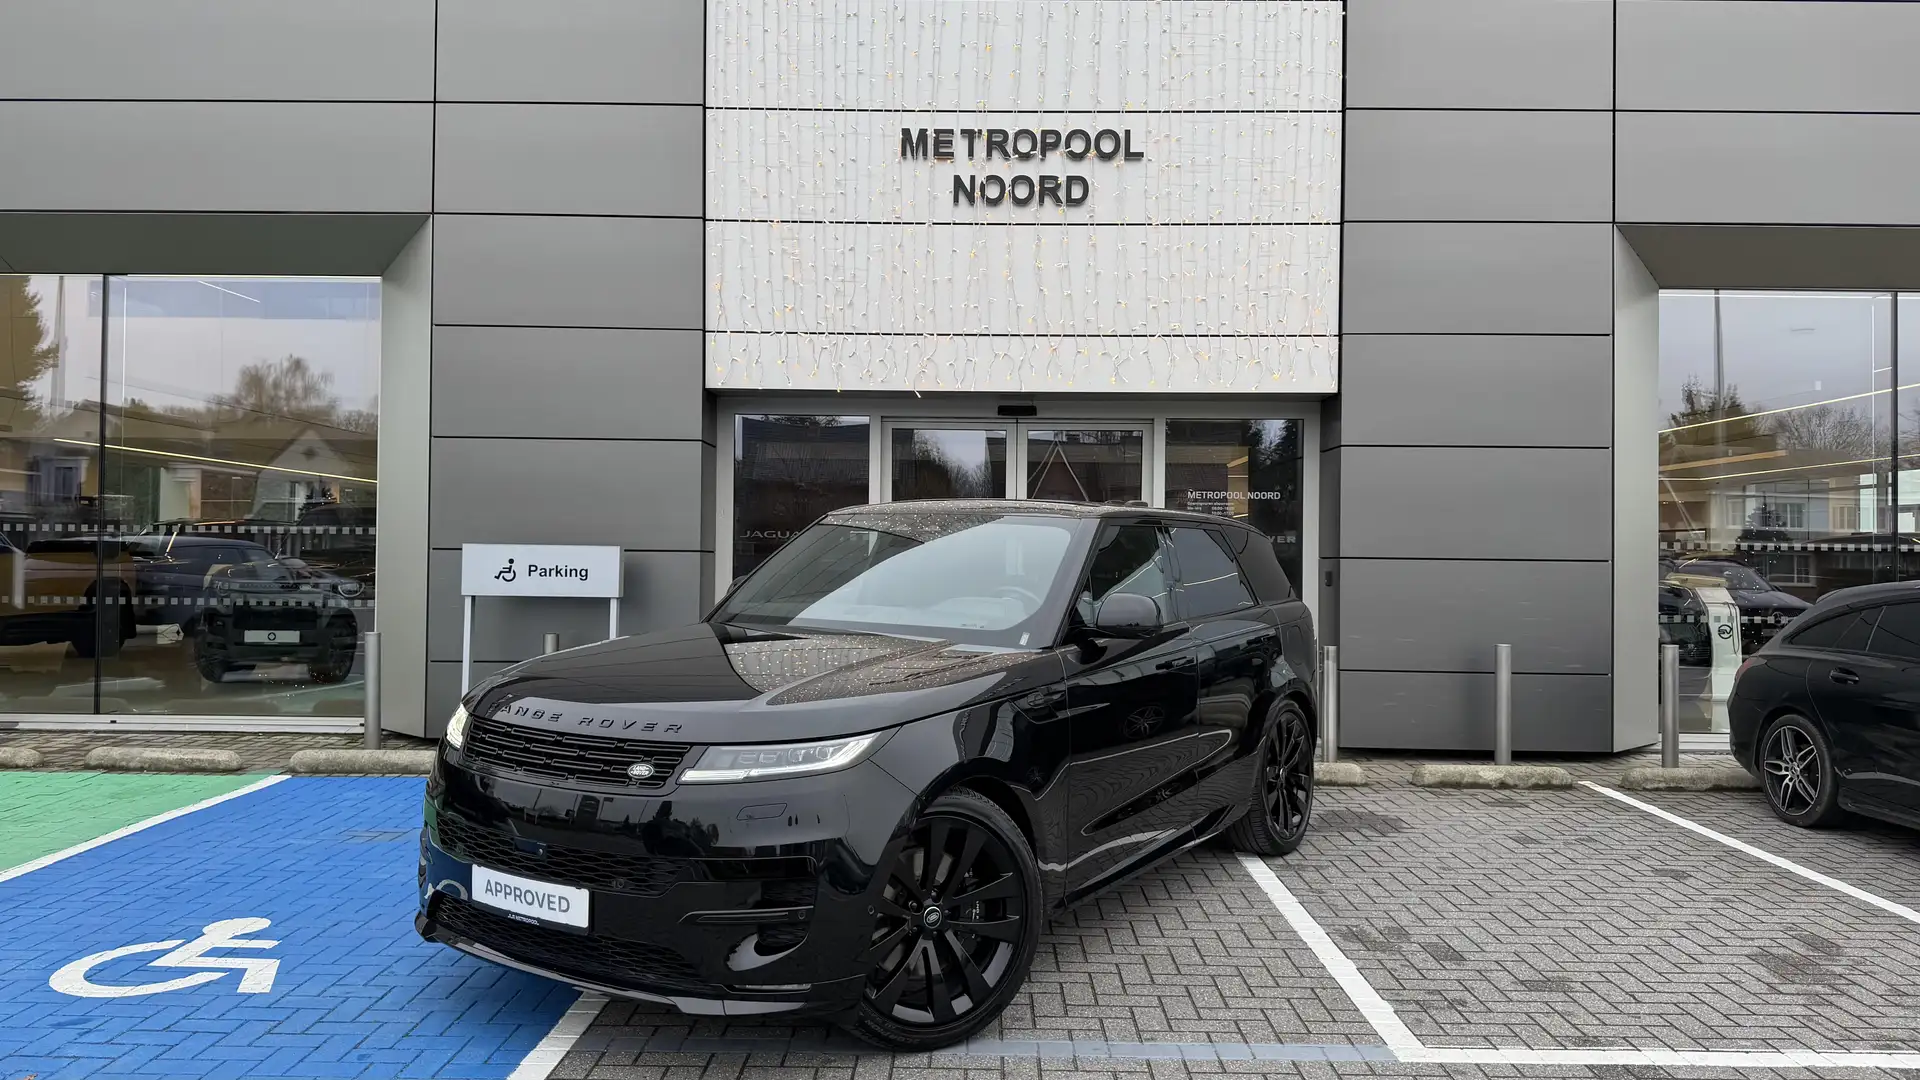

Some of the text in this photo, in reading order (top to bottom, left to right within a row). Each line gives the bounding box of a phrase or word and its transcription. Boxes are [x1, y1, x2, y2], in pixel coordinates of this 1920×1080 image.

[901, 128, 1145, 160] METROPOOL
[953, 174, 1090, 206] NOORD
[1187, 491, 1281, 500] METROPOOL NOORD
[740, 530, 801, 539] JAGUA
[528, 564, 589, 581] Parking
[578, 717, 683, 734] ROVER
[485, 879, 571, 913] APPROVED
